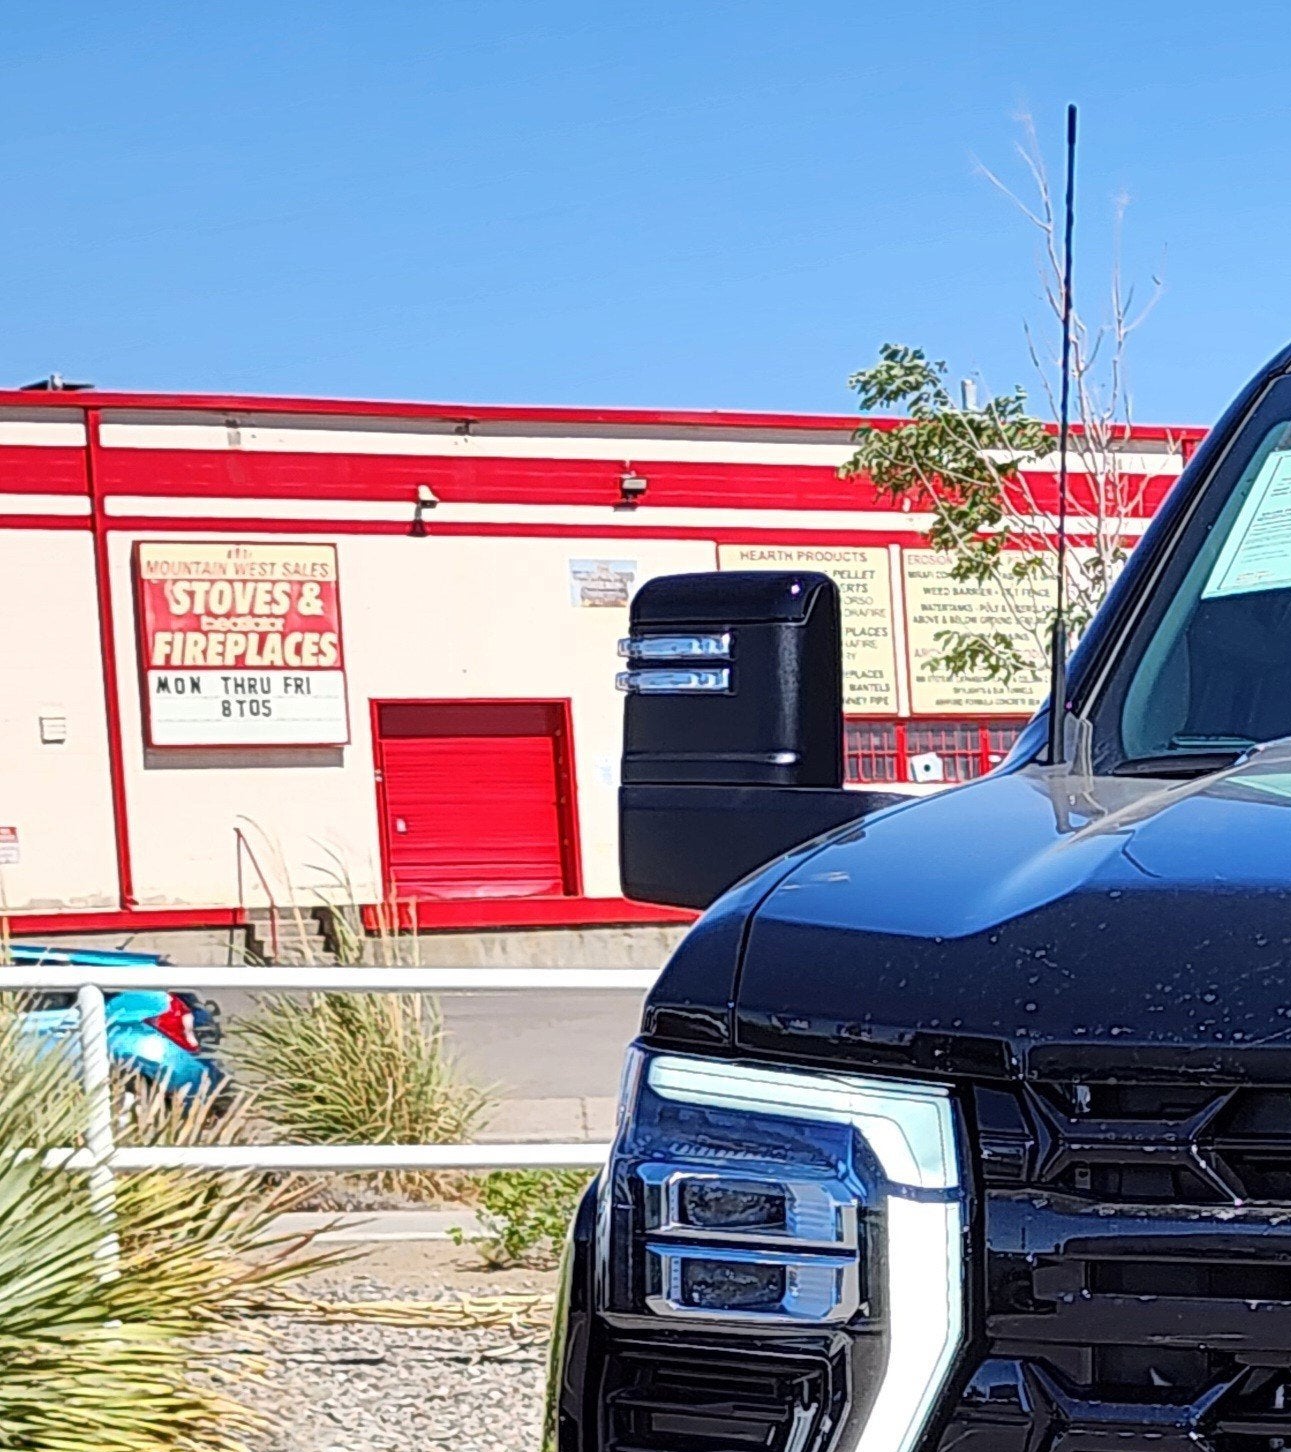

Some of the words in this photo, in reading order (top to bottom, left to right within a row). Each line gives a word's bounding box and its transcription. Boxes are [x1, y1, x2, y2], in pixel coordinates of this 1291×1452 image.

[740, 550, 793, 561] HEARTH
[797, 551, 868, 562] PRODUCTS
[146, 560, 227, 575] MOUNTAIN
[234, 561, 276, 576] WEST
[282, 562, 330, 578] SALES
[833, 570, 875, 580] PELLET
[168, 580, 291, 616] STOVES
[297, 581, 325, 616] &
[151, 631, 339, 667] FIREPLACES
[156, 676, 202, 695] MON
[221, 676, 271, 695] THRU
[283, 676, 312, 695] FRI
